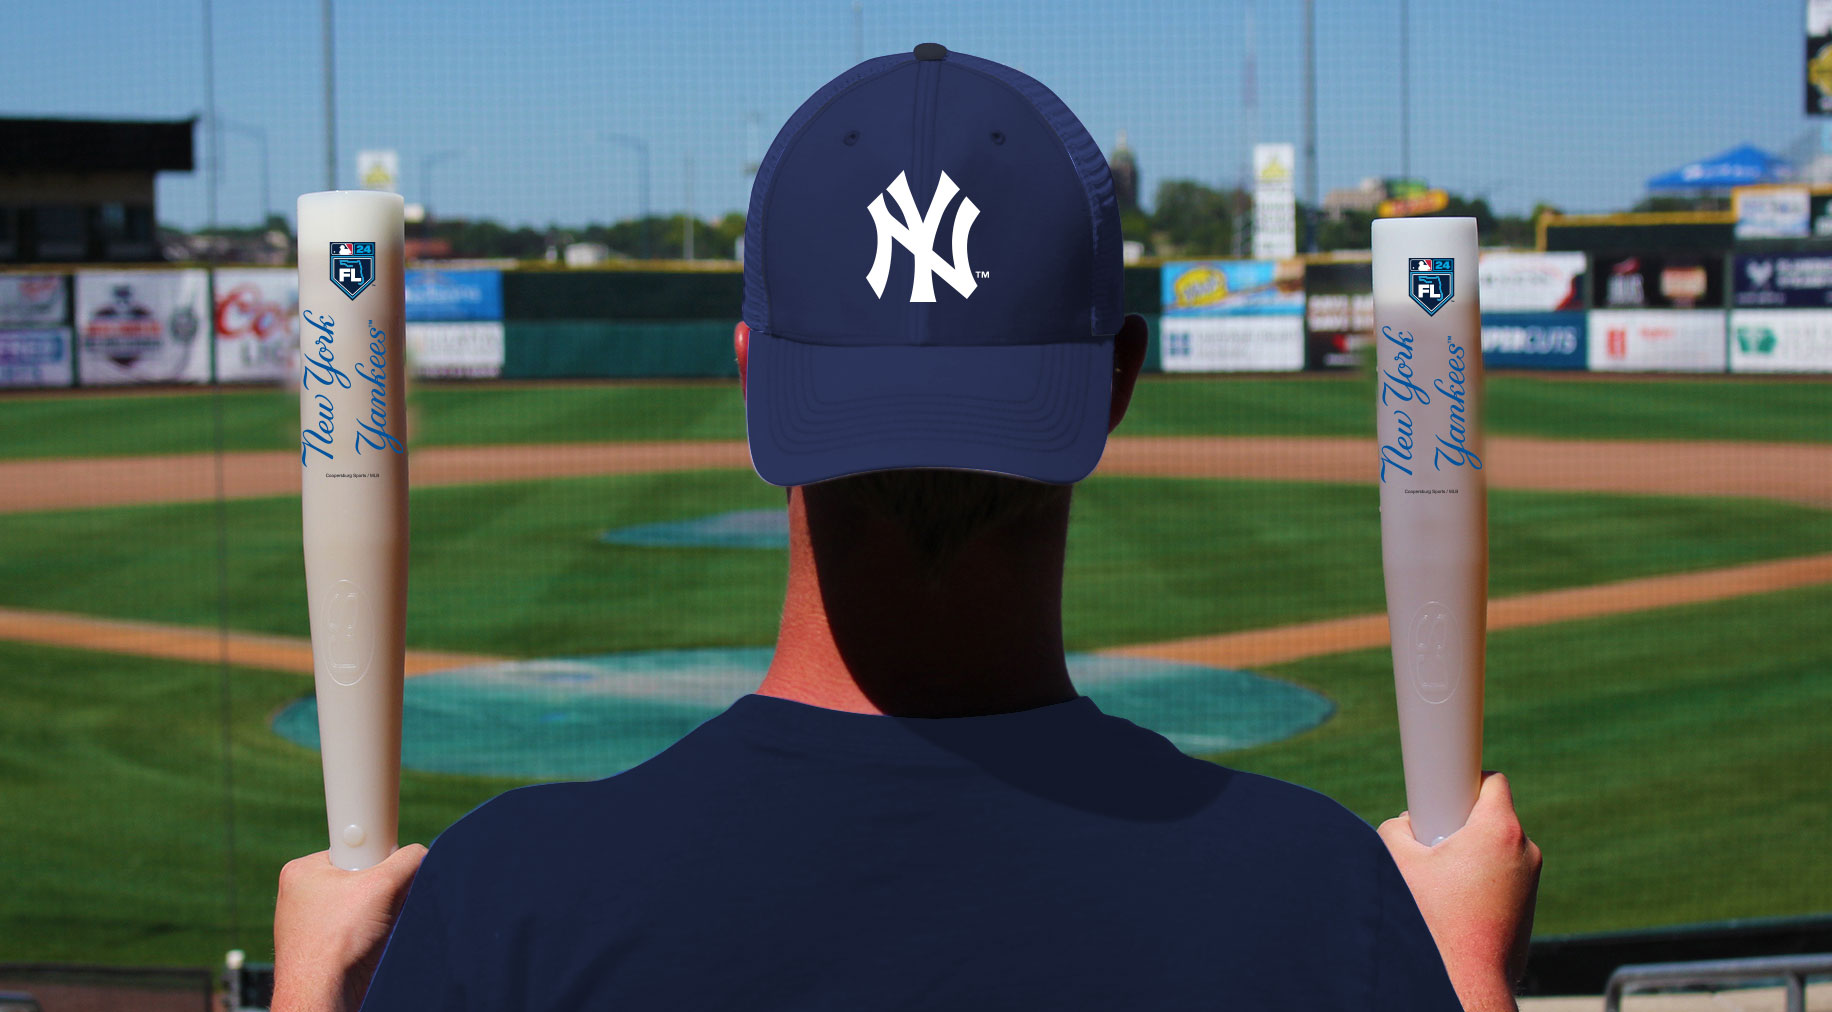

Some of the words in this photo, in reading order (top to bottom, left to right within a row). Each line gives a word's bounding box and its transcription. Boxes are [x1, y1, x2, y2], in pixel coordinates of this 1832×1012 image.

[356, 245, 372, 254] 24
[866, 169, 981, 303] NY
[1435, 261, 1451, 270] 24
[339, 268, 362, 282] FL
[1418, 284, 1441, 298] FL
[302, 309, 352, 391] York
[1381, 325, 1431, 407] York
[355, 326, 404, 455] Yankees
[1433, 343, 1483, 471] Yankees
[301, 394, 335, 467] New
[1380, 410, 1414, 483] New
